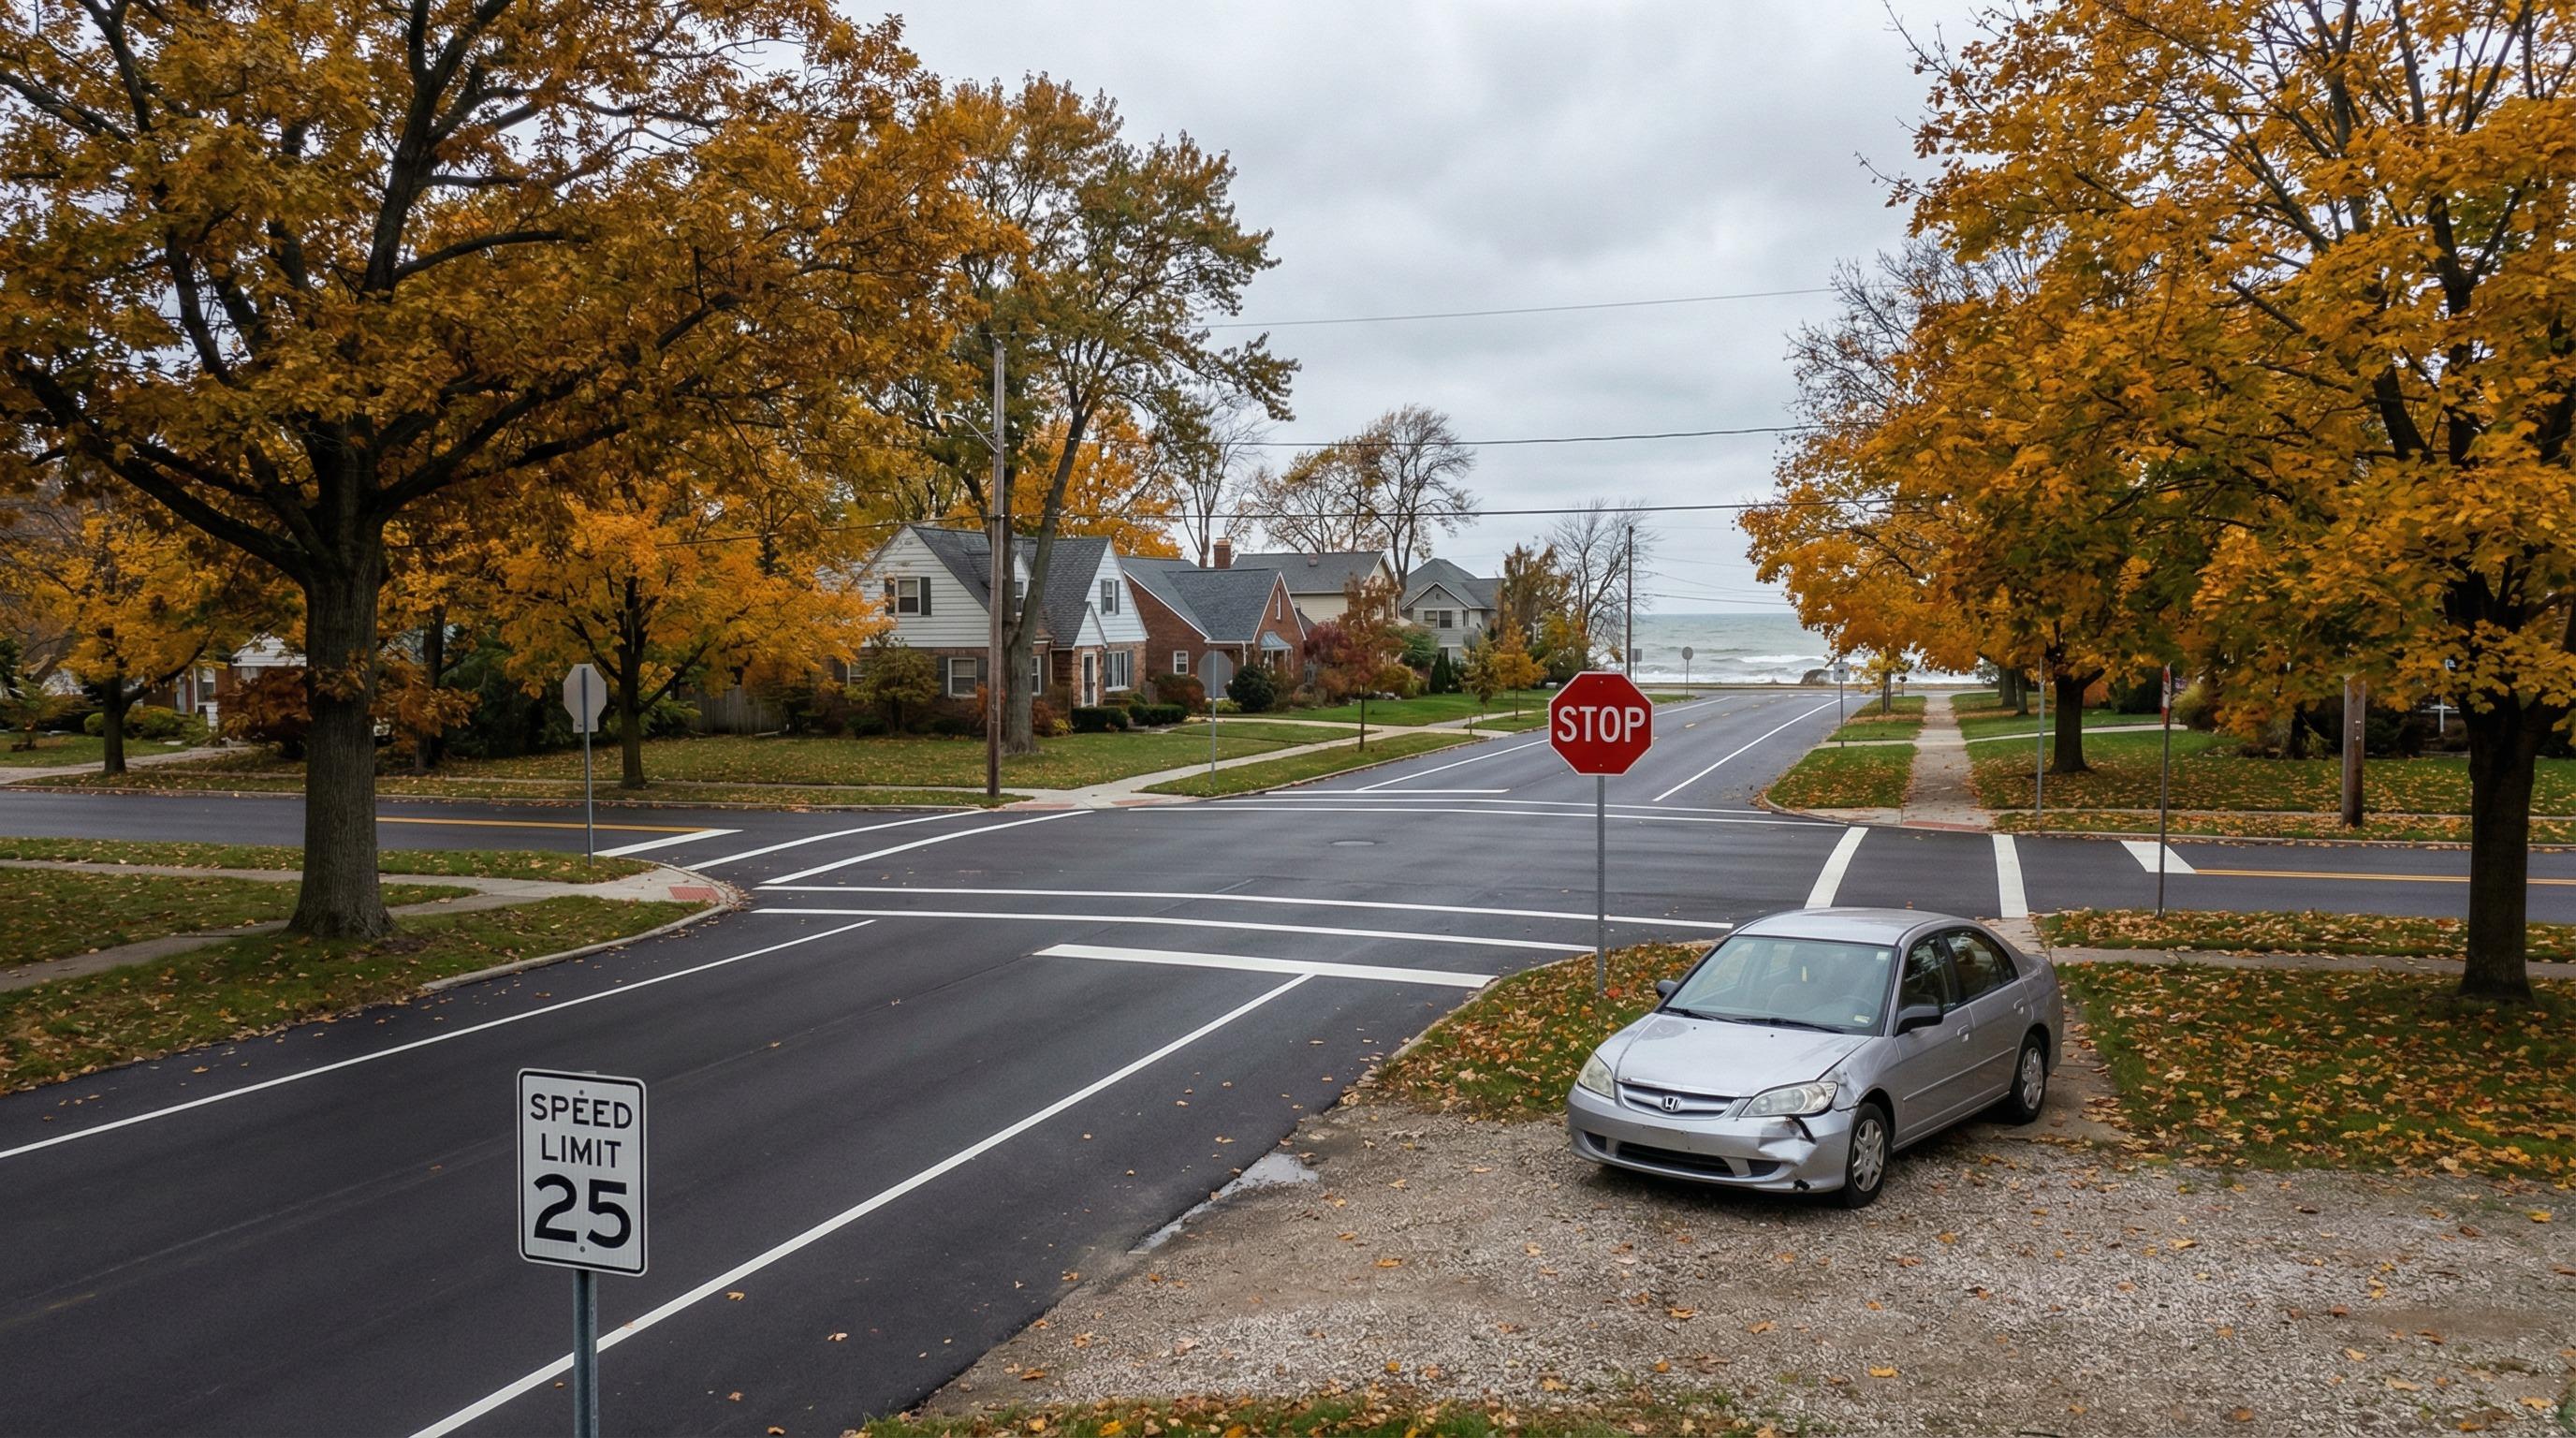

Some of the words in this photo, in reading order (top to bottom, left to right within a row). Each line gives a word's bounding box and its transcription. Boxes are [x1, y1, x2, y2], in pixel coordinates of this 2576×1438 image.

[1557, 705, 1646, 742] STOP
[530, 1093, 633, 1129] SPEED
[541, 1133, 622, 1168] LIMIT
[534, 1173, 632, 1249] 25
